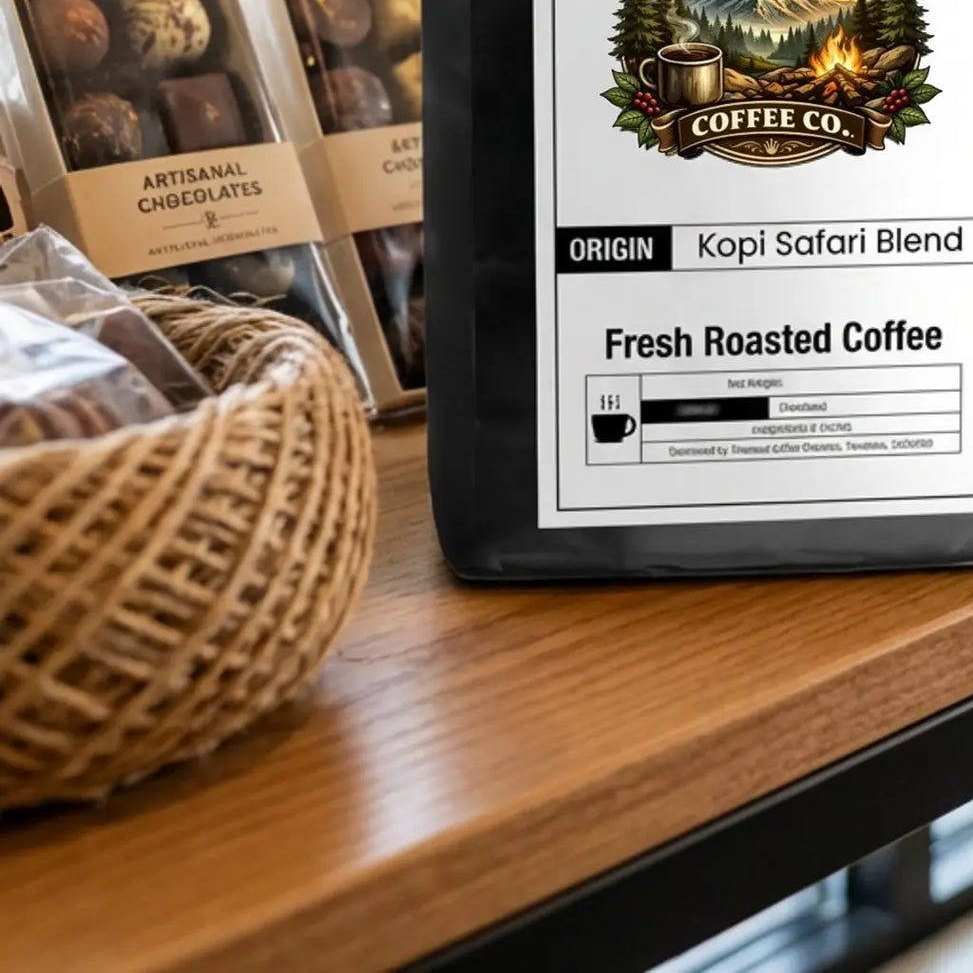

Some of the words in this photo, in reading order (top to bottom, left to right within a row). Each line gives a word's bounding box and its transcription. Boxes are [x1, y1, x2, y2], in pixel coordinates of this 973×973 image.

[691, 107, 796, 137] COFFEE
[802, 110, 851, 137] CO.
[143, 162, 248, 190] ARTISANAL
[569, 237, 653, 262] ORIGIN
[698, 229, 766, 265] Kopi
[775, 227, 866, 257] Safari
[876, 226, 964, 254] Blend
[605, 325, 693, 359] Fresh
[704, 323, 831, 356] Roasted
[842, 319, 943, 352] Coffee
